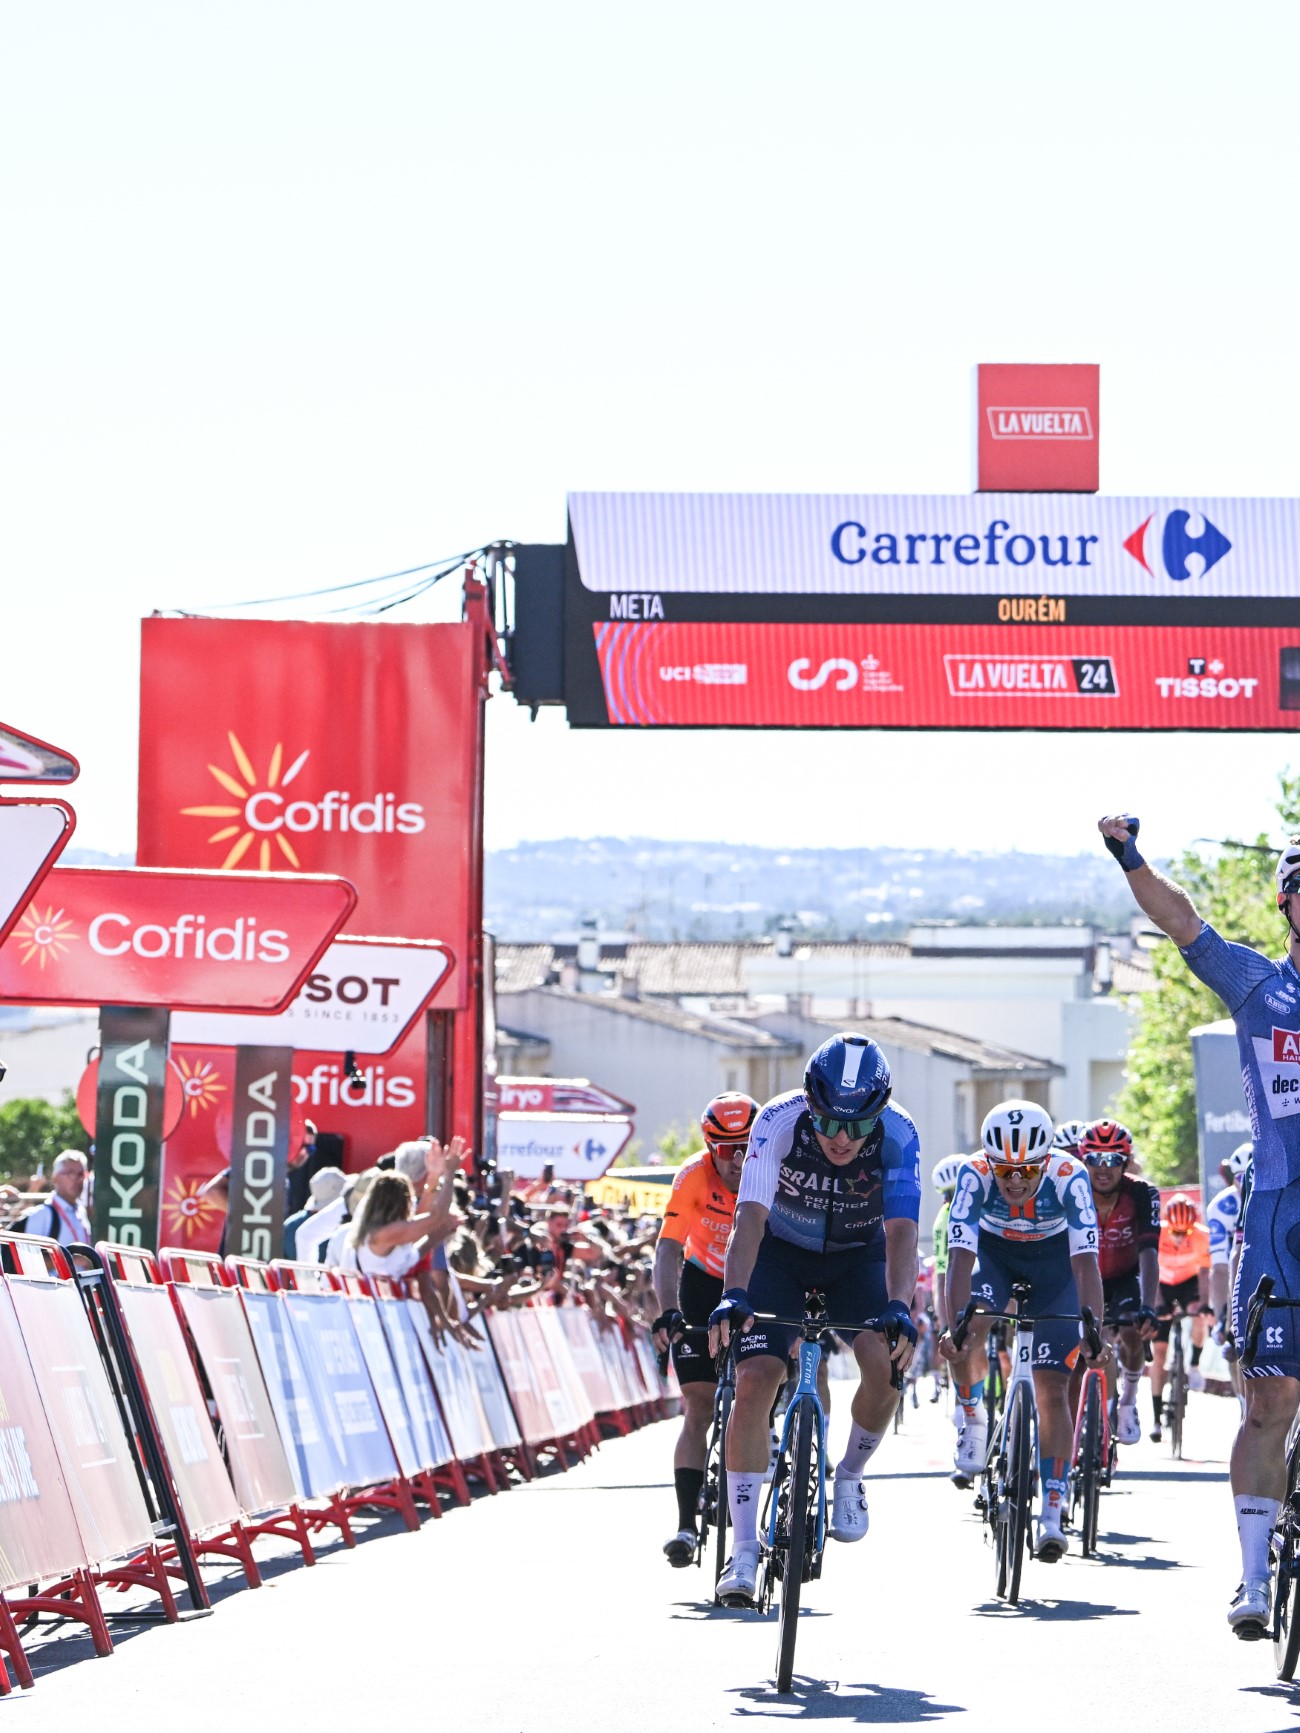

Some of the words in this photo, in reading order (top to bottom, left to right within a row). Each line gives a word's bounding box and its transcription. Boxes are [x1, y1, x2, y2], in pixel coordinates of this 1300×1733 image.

[999, 412, 1020, 434] LA
[1021, 413, 1082, 434] VUELTA
[831, 519, 1099, 567] Carrefour
[609, 594, 665, 620] META
[997, 594, 1066, 622] OURÉM
[659, 666, 691, 681] UCI
[958, 662, 985, 689] LA
[987, 663, 1067, 690] VUELTA
[1080, 663, 1108, 690] 24
[1155, 677, 1258, 699] TISSOT
[244, 791, 426, 834] Cofidis
[88, 911, 291, 963] Cofidis
[304, 1009, 353, 1022] SINCE
[363, 1011, 400, 1024] 1853
[500, 1085, 544, 1110] iryo
[804, 1195, 869, 1209] PREMIER
[805, 1201, 844, 1214] TECH
[740, 1334, 767, 1343] RACING
[740, 1342, 768, 1352] CHANGE
[803, 1350, 813, 1385] FACTOR
